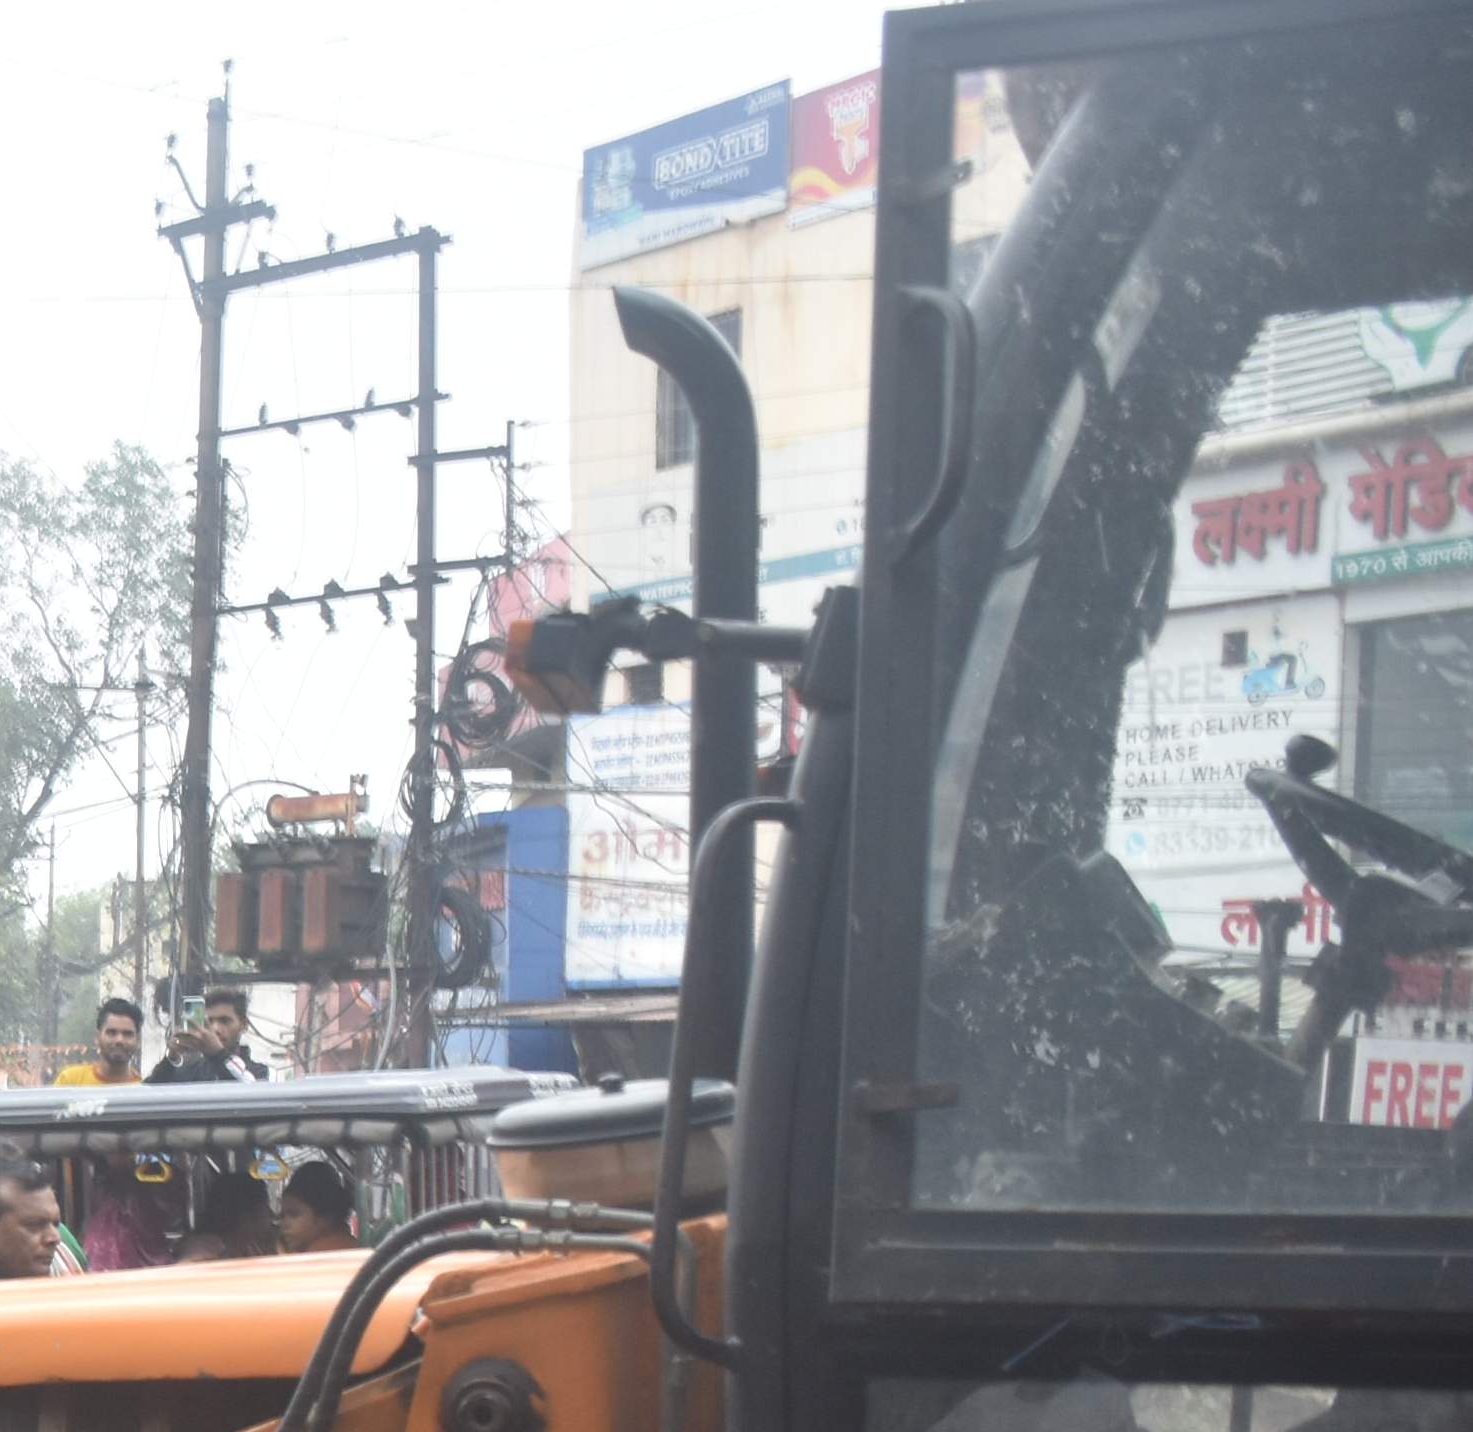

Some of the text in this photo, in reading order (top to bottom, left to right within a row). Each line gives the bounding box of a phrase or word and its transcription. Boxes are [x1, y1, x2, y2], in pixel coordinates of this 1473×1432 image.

[659, 126, 765, 181] BOND TITE
[1336, 558, 1387, 580] 1970
[1125, 709, 1294, 745] HOME DELIVERY
[1125, 745, 1199, 767] PLEASE
[1125, 768, 1172, 789] CALL
